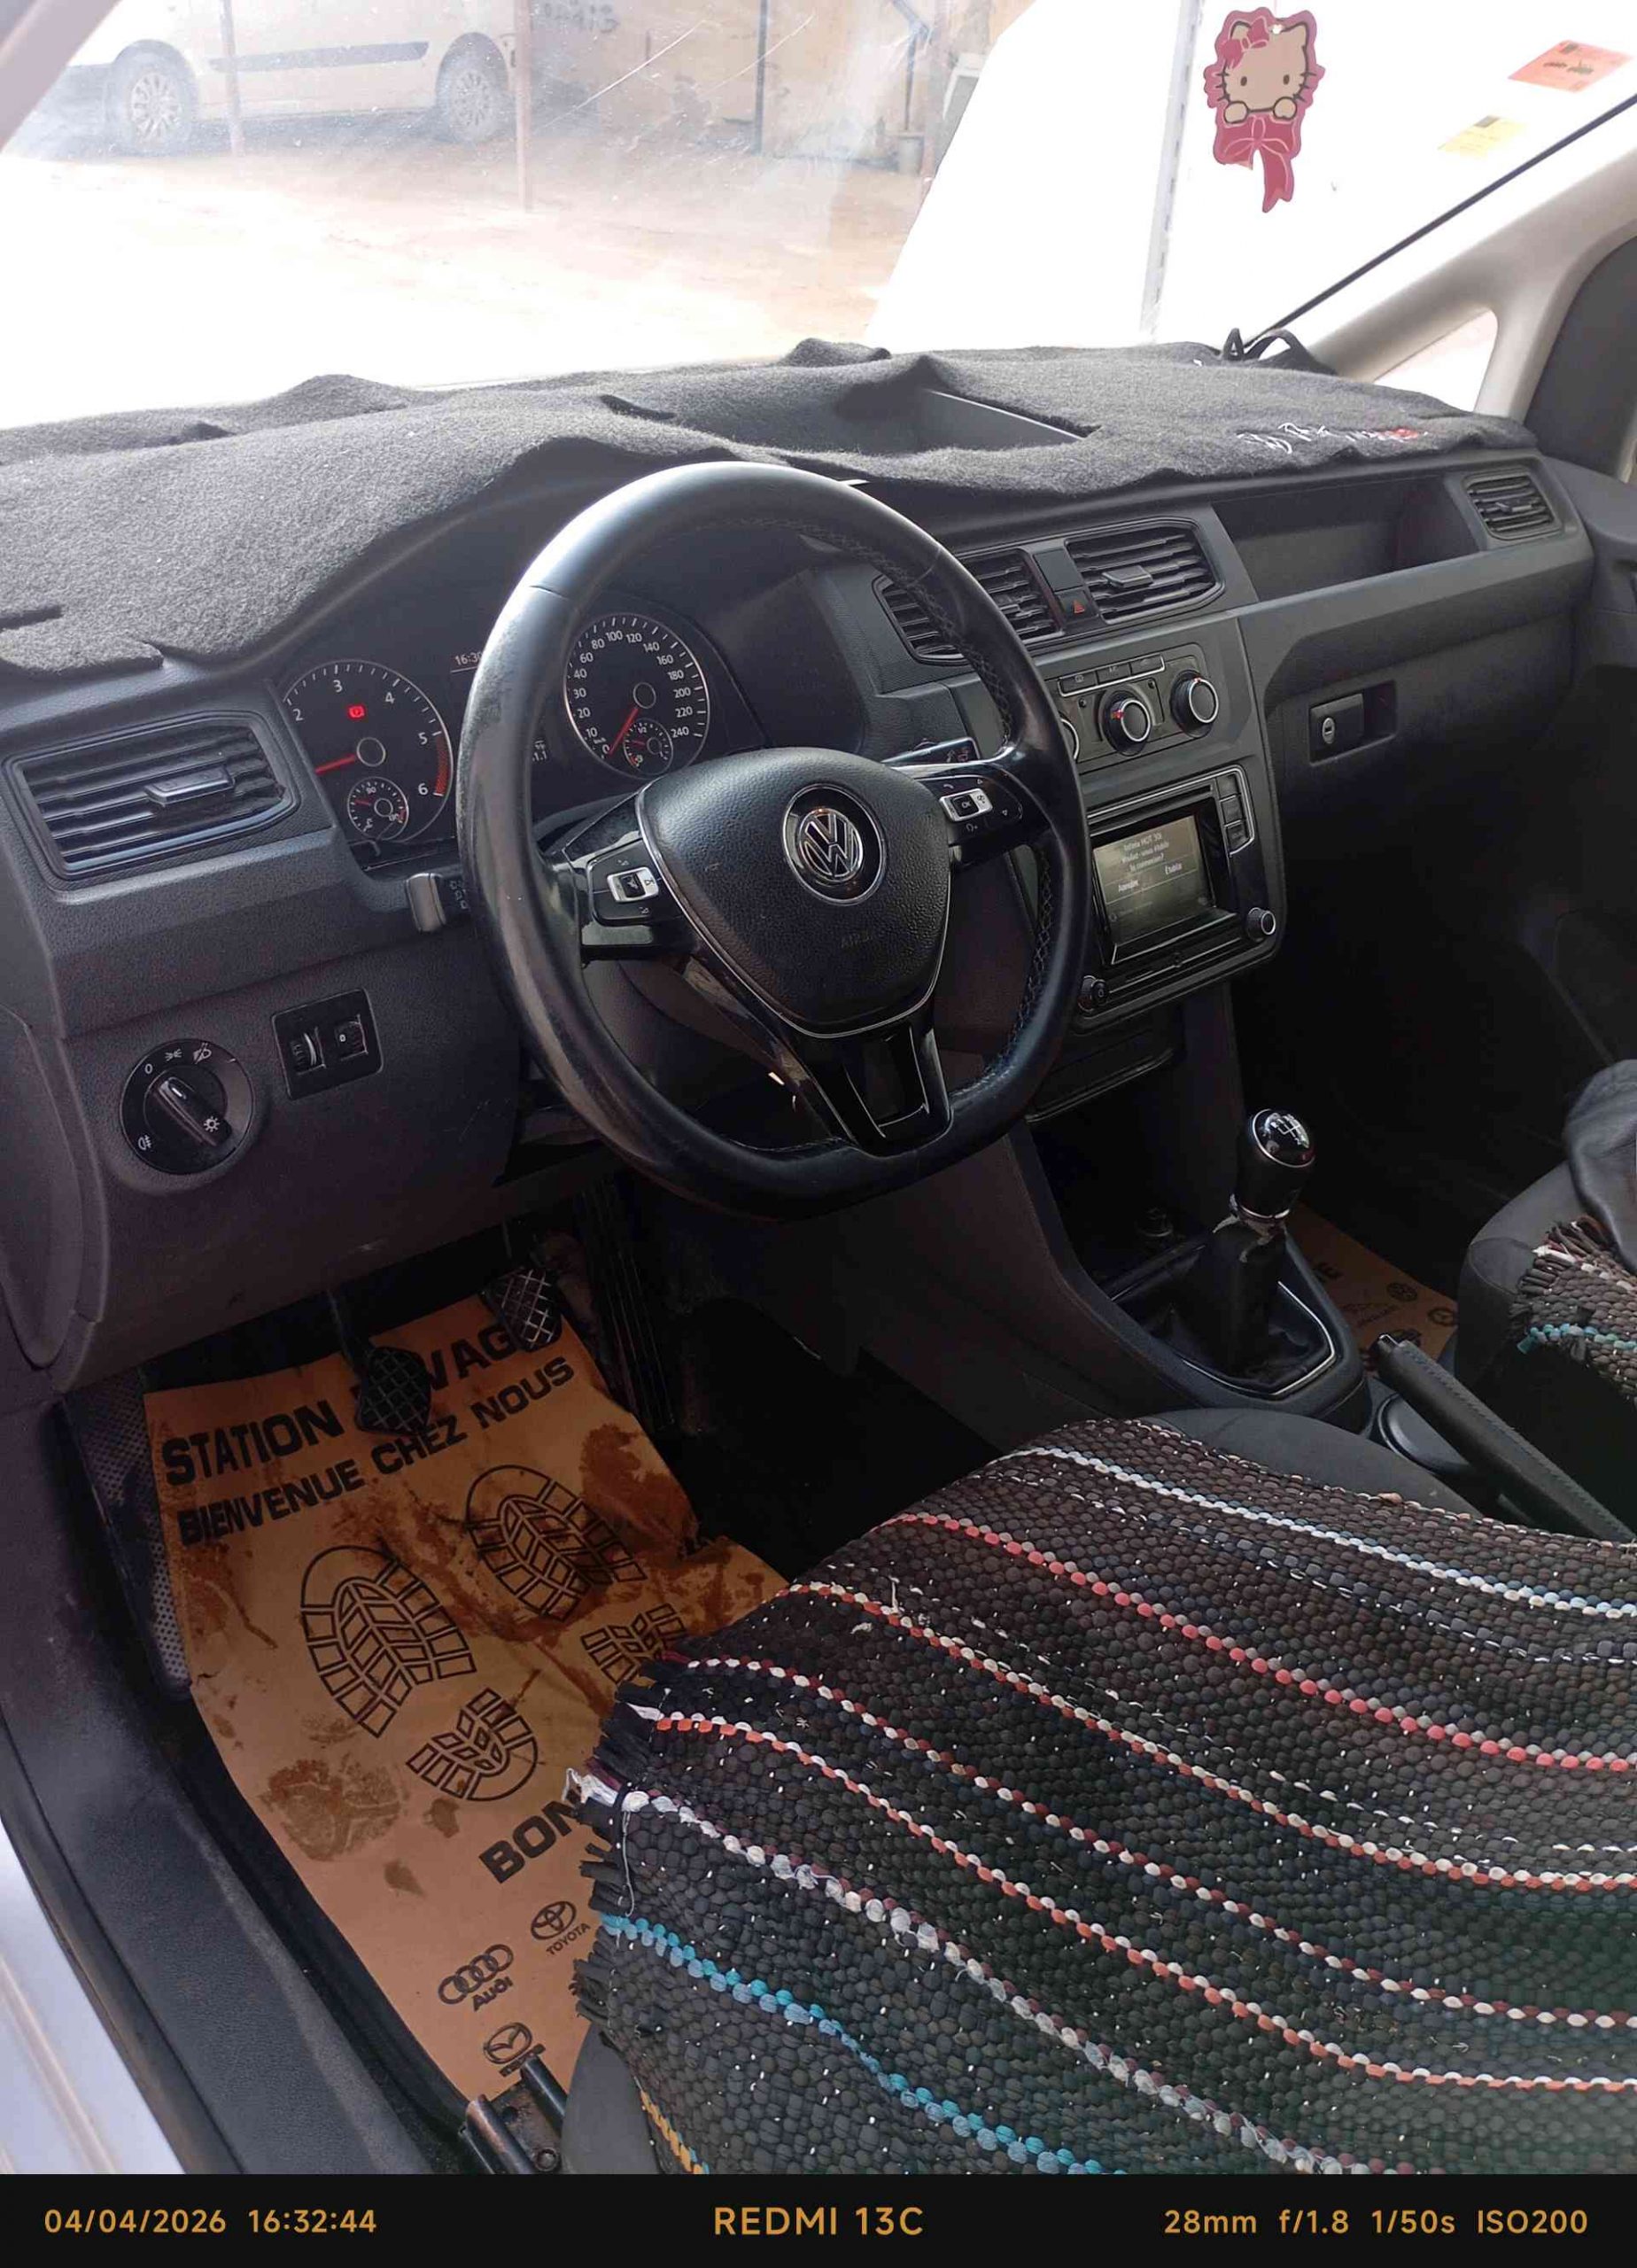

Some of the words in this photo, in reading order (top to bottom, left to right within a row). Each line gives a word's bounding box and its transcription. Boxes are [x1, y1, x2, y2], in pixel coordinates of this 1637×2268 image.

[606, 630, 623, 642] 100
[626, 633, 642, 644] 120
[591, 638, 605, 649] 80
[643, 641, 660, 653] 140
[579, 652, 594, 664] 60
[656, 654, 674, 665] 160
[574, 668, 587, 679] 40
[668, 669, 684, 680] 180
[333, 680, 344, 693] 3
[673, 687, 691, 698] 200
[384, 692, 395, 704] 4
[574, 687, 586, 699] 30
[292, 709, 304, 721] 2
[578, 707, 591, 718] 20
[675, 706, 694, 718] 220
[418, 732, 428, 744] 5
[586, 727, 598, 738] 10
[671, 726, 690, 738] 240
[602, 744, 610, 754] 0
[417, 782, 429, 796] 6
[144, 1063, 153, 1075] 0
[161, 1400, 345, 1487] STATION
[177, 1458, 366, 1546] BIENVENUE
[370, 1415, 468, 1475] CHEZ
[470, 1355, 574, 1430] NOUS
[546, 1922, 592, 1955] TOYOTA
